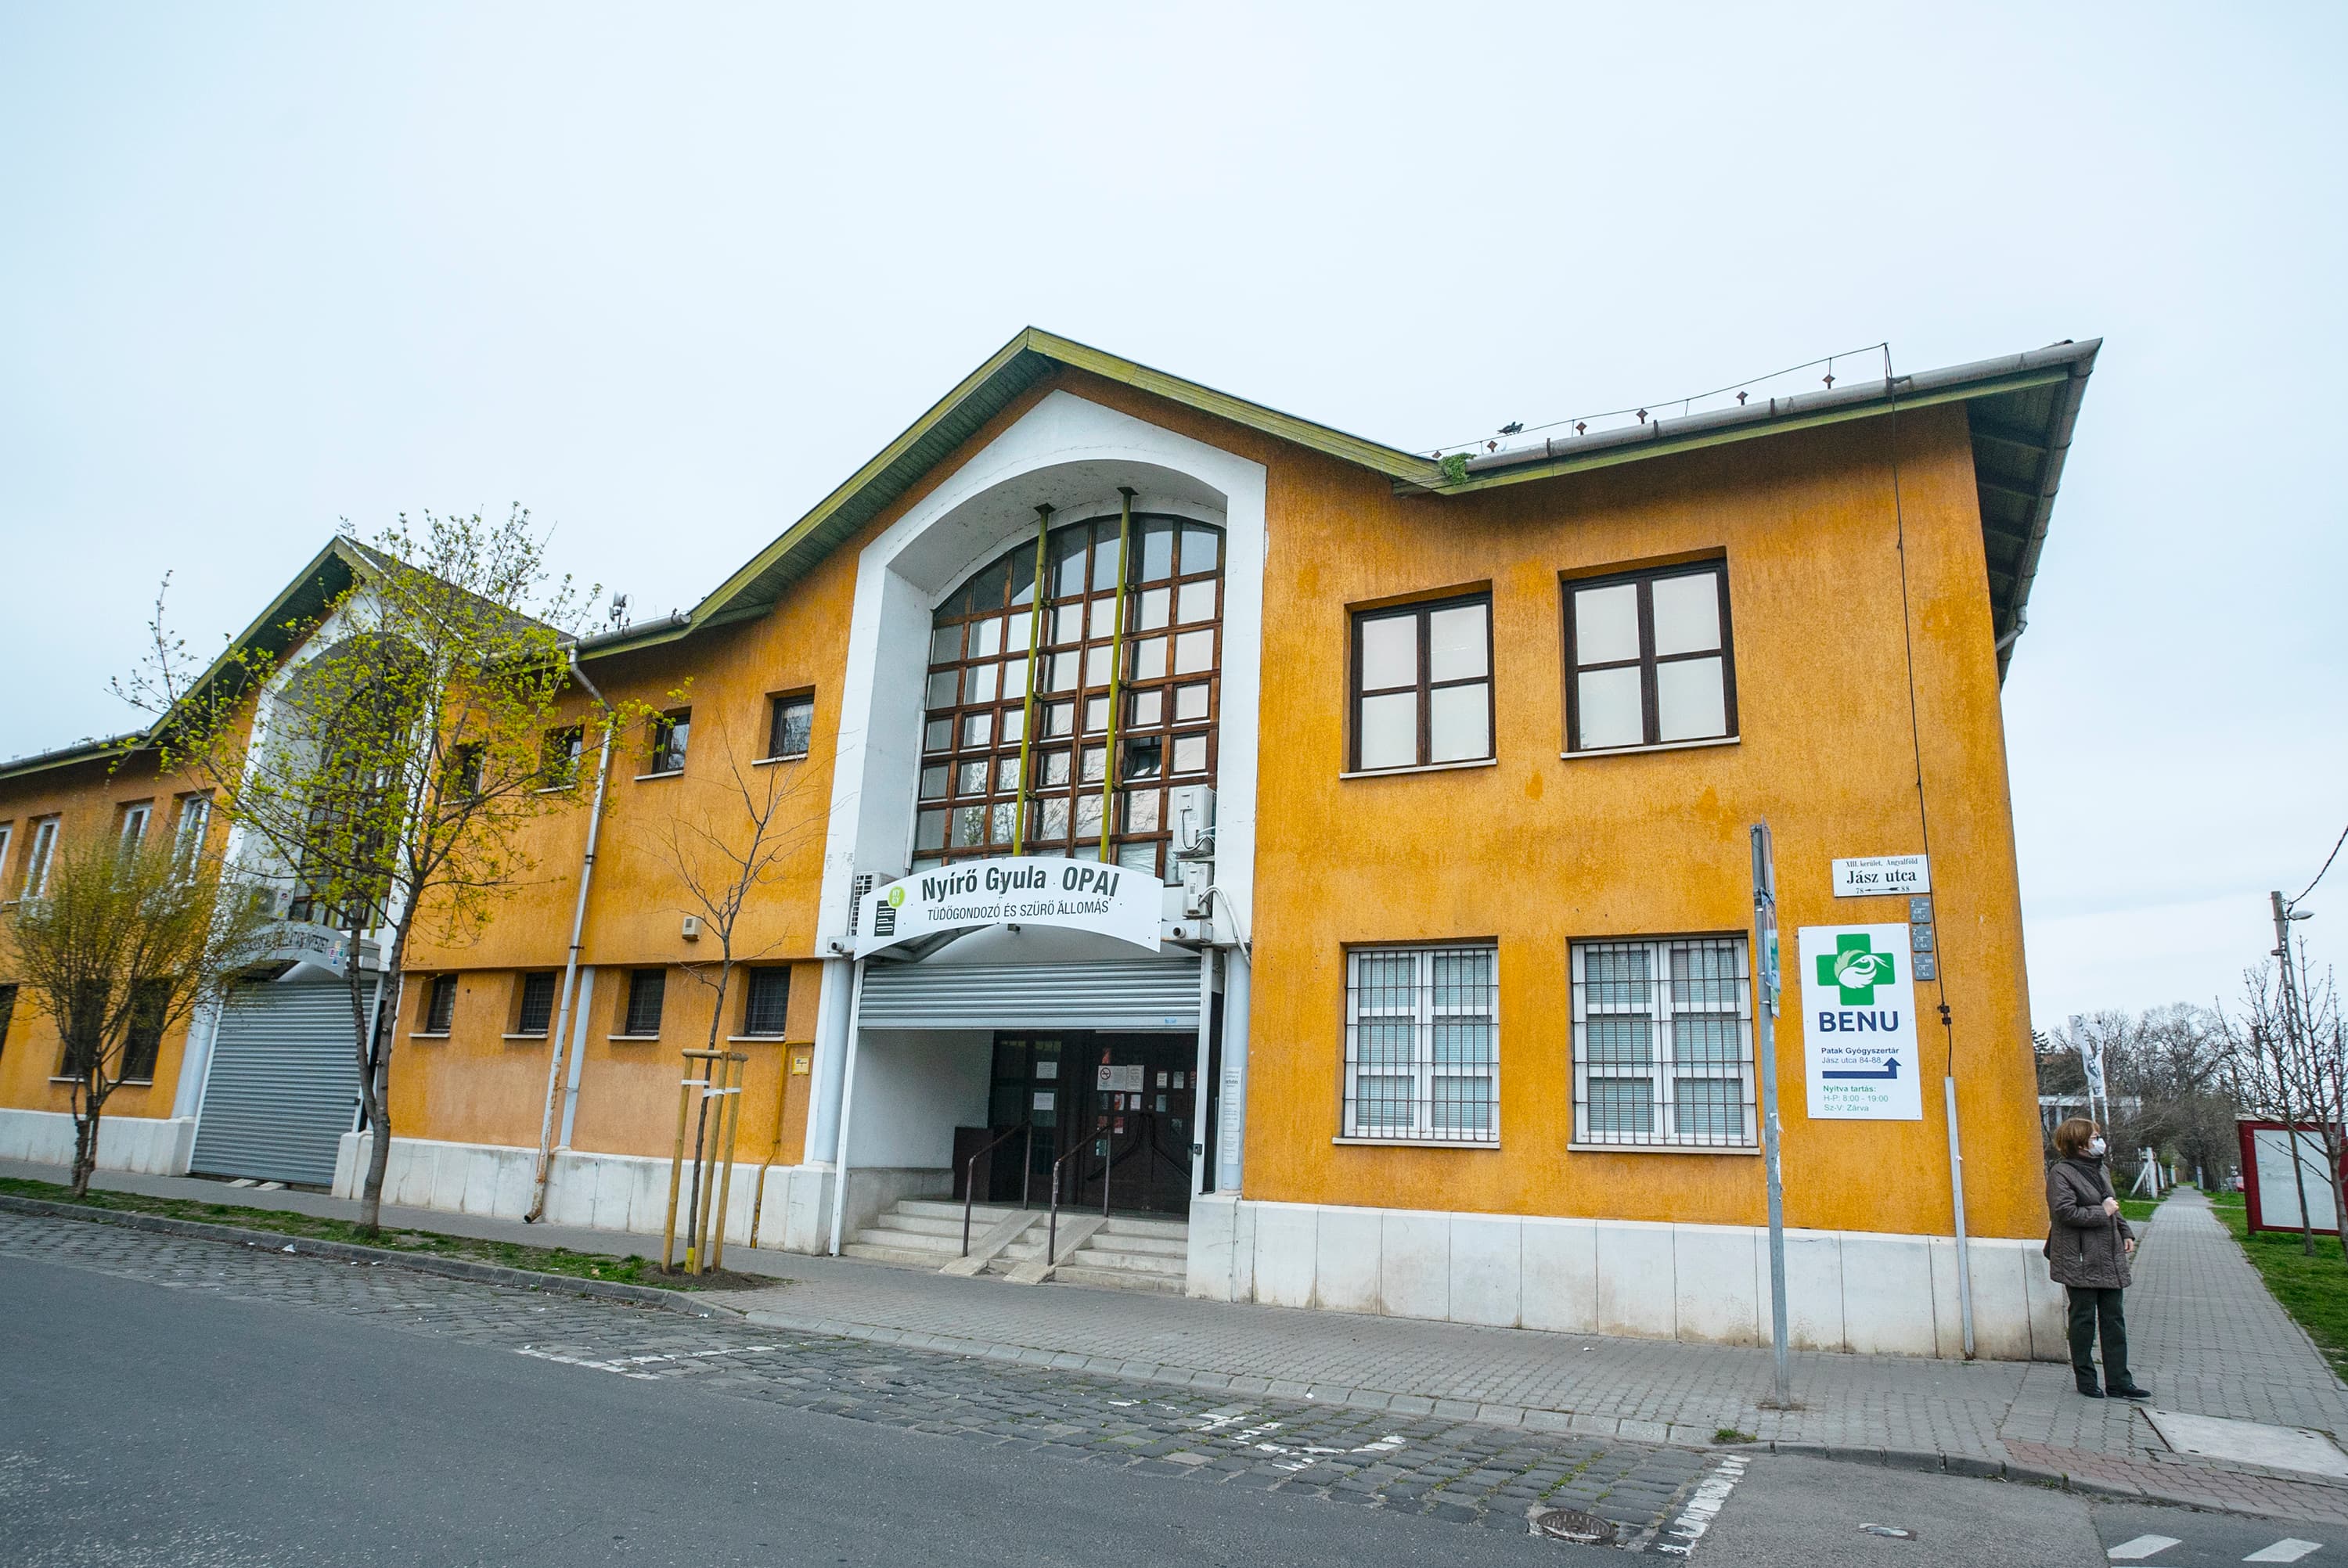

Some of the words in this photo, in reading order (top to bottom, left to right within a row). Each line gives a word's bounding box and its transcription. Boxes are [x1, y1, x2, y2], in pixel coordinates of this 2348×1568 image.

[1887, 858, 1918, 867] Angyalföld
[922, 869, 978, 902] Nyírő
[985, 865, 1046, 894] Gyula
[1062, 866, 1120, 897] OPAI
[1846, 870, 1879, 884] Jász
[1885, 869, 1917, 882] utca
[927, 903, 1001, 921] TÜDŐGONDOZÓ
[1004, 903, 1017, 917] ÉS
[1020, 900, 1054, 917] SZŰRŐ
[1057, 898, 1109, 915] ÁLLOMÁS
[1819, 1011, 1899, 1032] BENU
[1846, 1047, 1900, 1056] Gyógyszertár
[1846, 1103, 1869, 1112] Zárva
